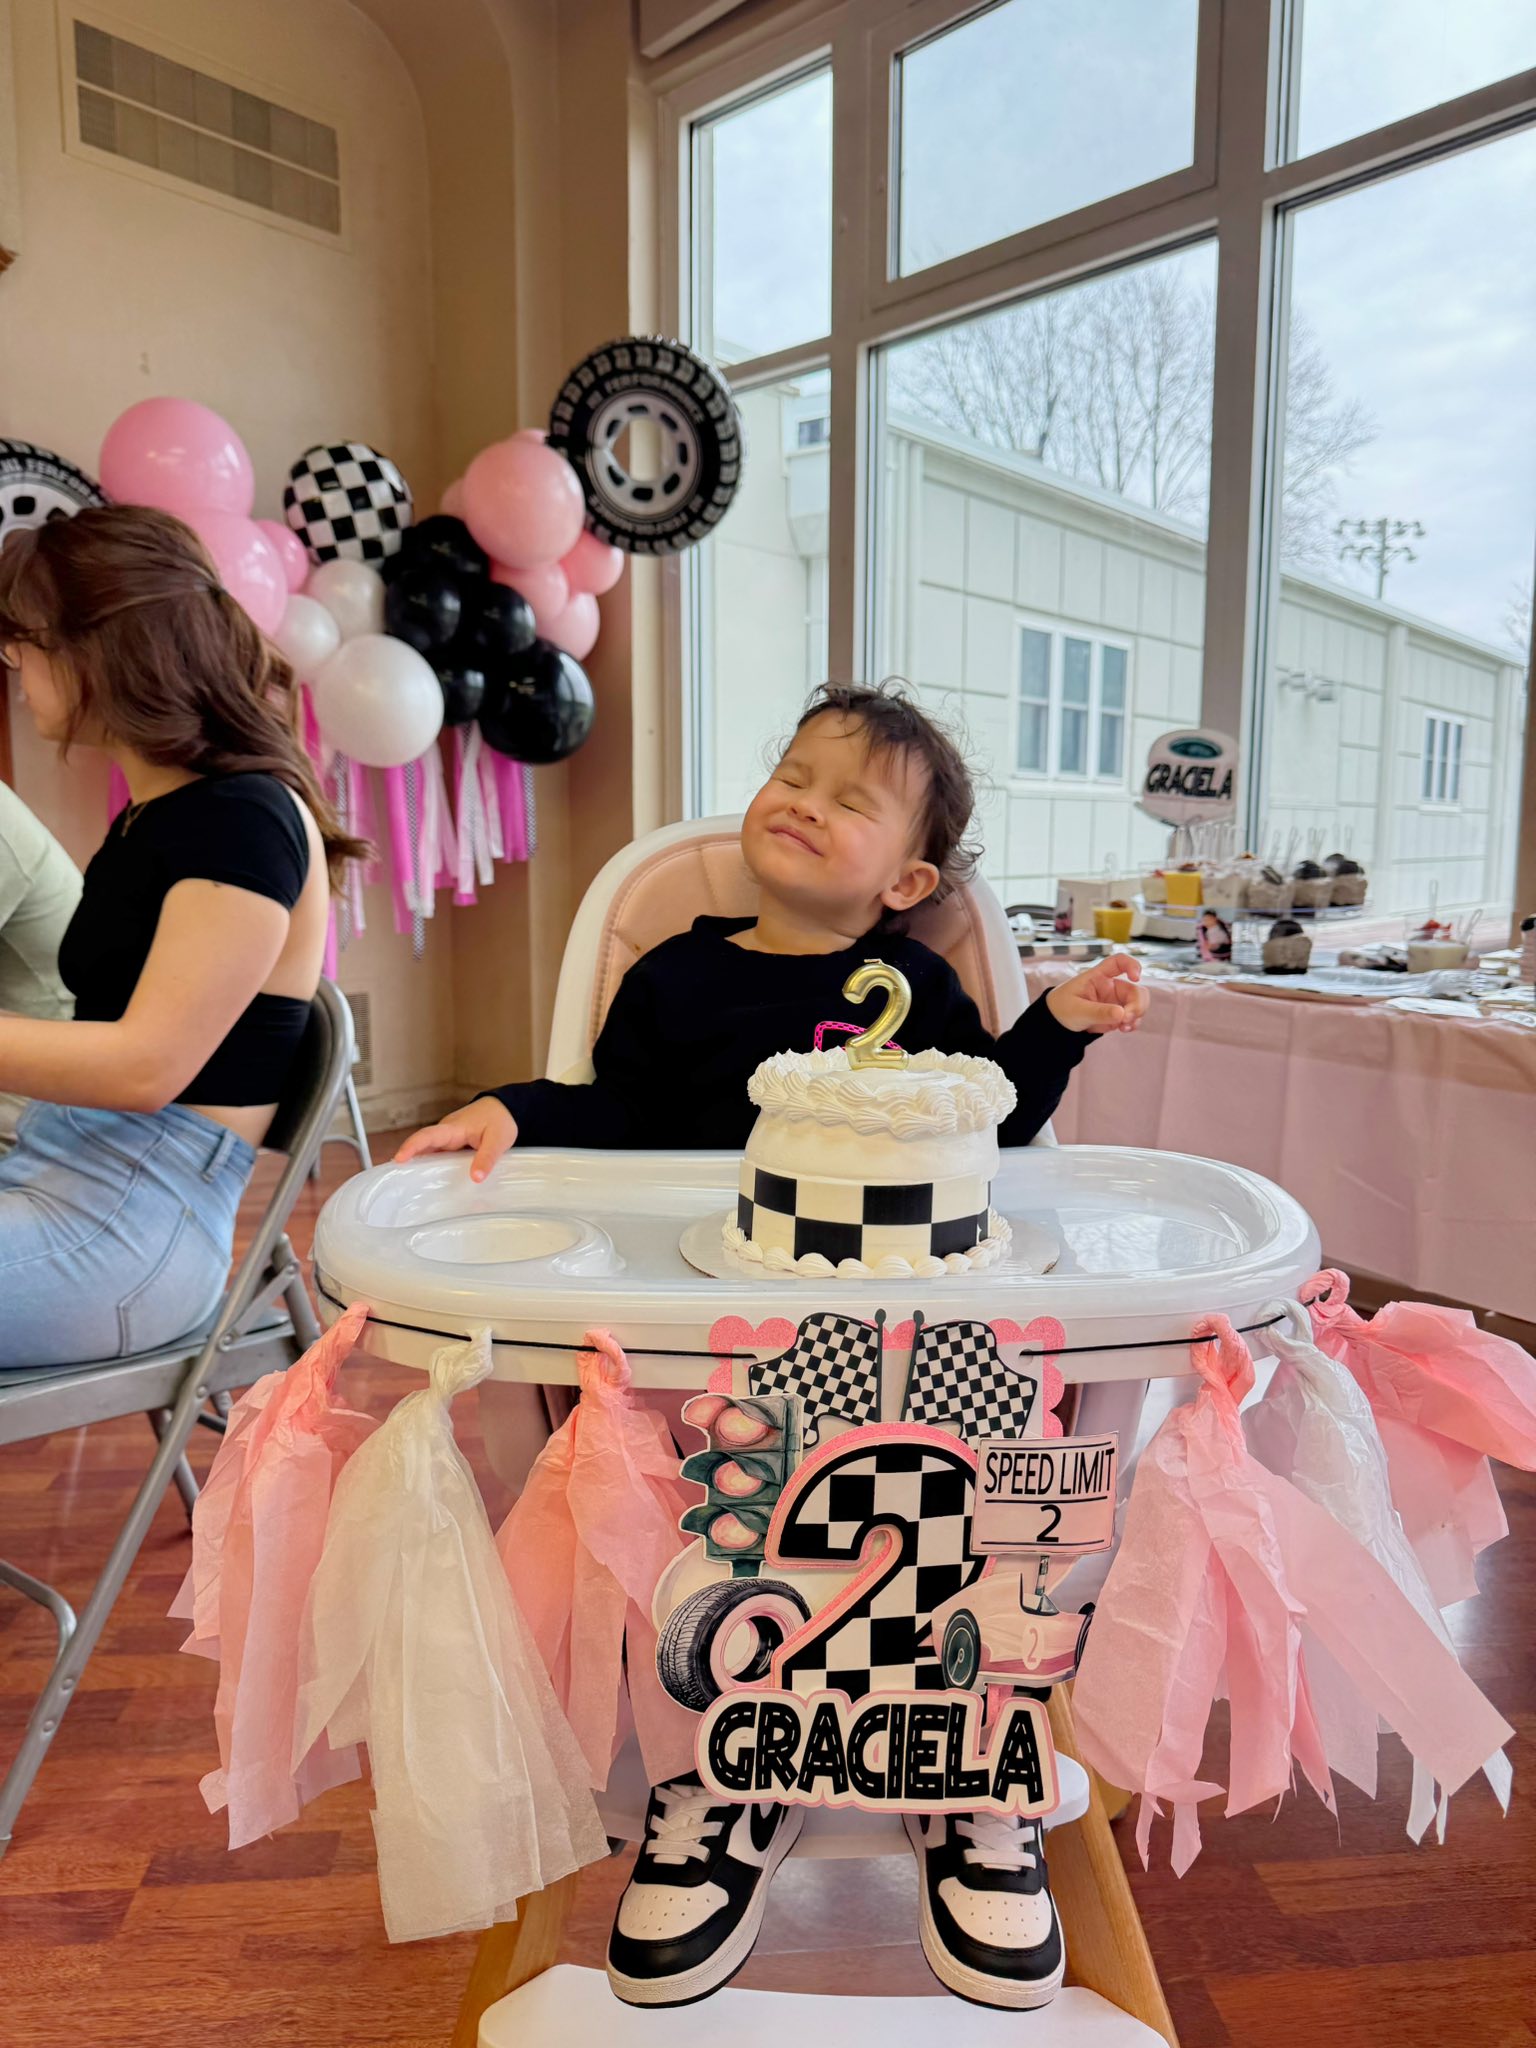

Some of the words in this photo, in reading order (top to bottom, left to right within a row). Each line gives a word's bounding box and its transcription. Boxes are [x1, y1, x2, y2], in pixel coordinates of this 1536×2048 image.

[842, 960, 912, 1071] 2
[984, 1452, 1054, 1495] SPEED
[1059, 1447, 1115, 1495] LIMIT
[1036, 1504, 1062, 1543] 2
[777, 1442, 987, 1692] 2
[1027, 1627, 1039, 1663] 2
[707, 1701, 1045, 1805] GRACIELA
